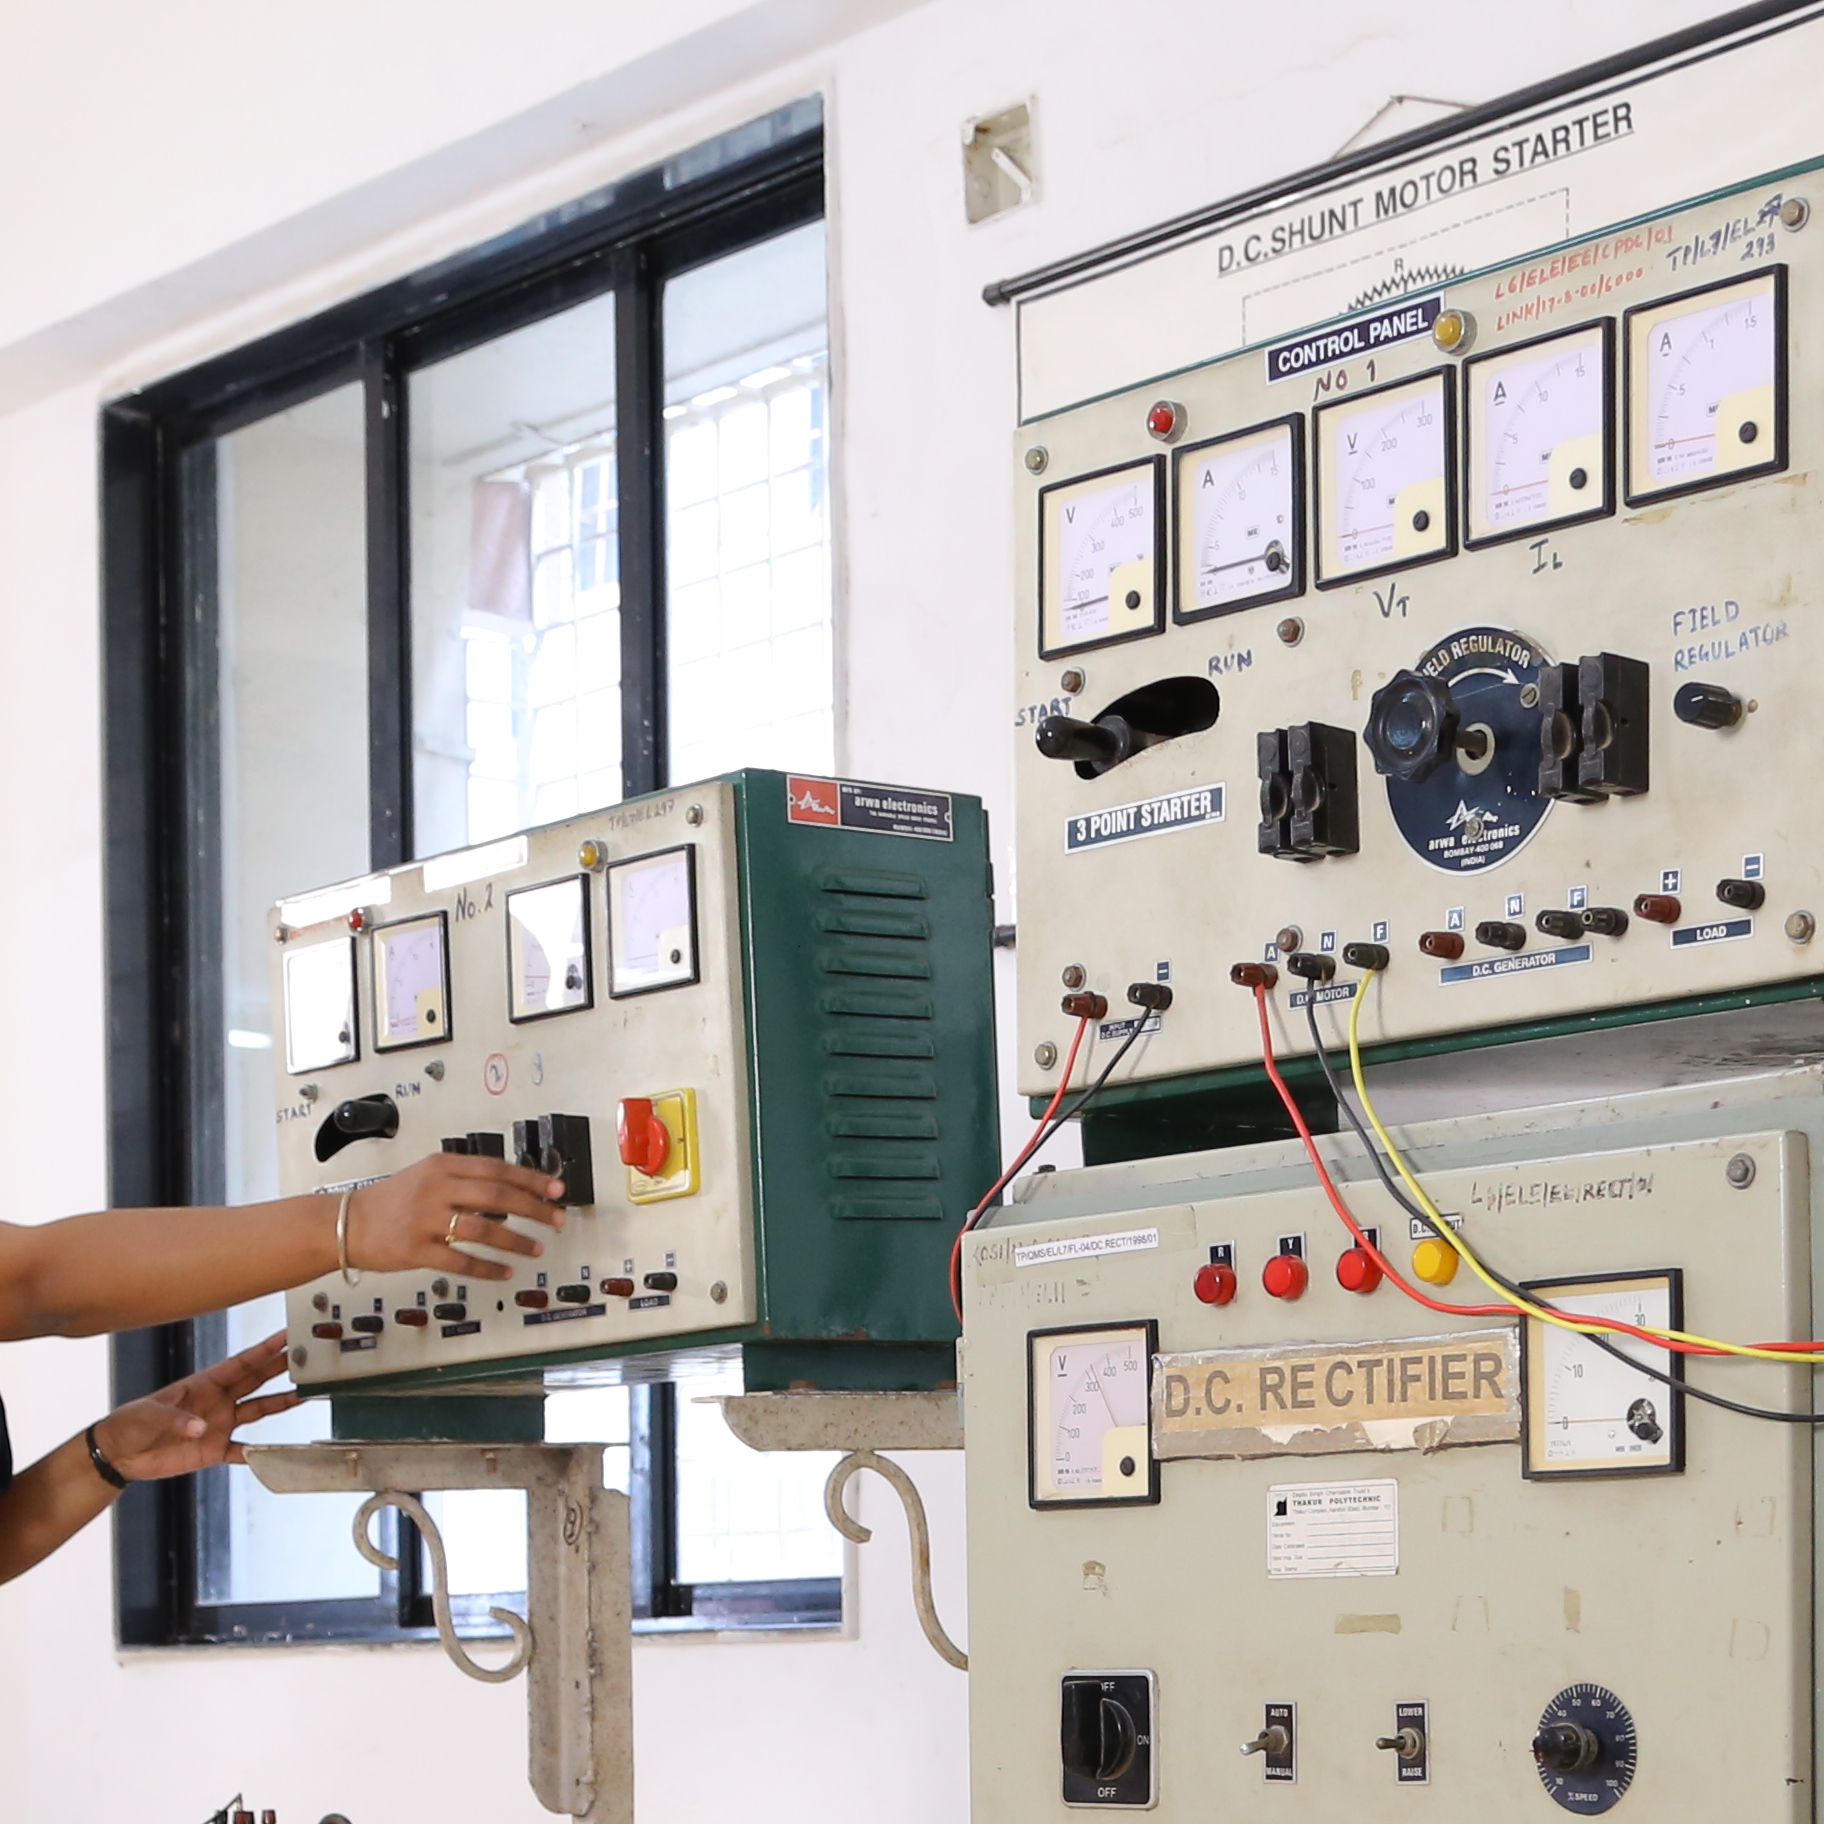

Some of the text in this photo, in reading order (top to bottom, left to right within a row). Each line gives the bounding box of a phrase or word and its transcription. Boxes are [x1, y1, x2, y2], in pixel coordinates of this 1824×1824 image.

[1376, 158, 1477, 219] MOTOR
[1493, 101, 1633, 177] STARTER
[1394, 258, 1404, 273] R
[1278, 308, 1428, 372] CONTROL PANEL
[1659, 332, 1672, 352] A
[1366, 359, 1376, 382] 1
[1493, 381, 1507, 401] A
[1415, 413, 1434, 429] 300
[1346, 432, 1358, 451] V
[1380, 436, 1398, 453] 200
[1202, 469, 1215, 489] A
[1360, 477, 1377, 491] 100
[1065, 506, 1076, 524] V
[1127, 505, 1145, 521] 500
[1109, 515, 1126, 529] 400
[1673, 600, 1739, 636] FIELD
[1450, 635, 1531, 669] REGULATOR
[1674, 620, 1789, 672] REGULATOR
[1208, 649, 1252, 676] RUN
[1014, 697, 1072, 727] START
[854, 795, 881, 809] arwa
[882, 798, 938, 816] electronics
[1077, 791, 1211, 841] 3 POINT STARTER
[1427, 835, 1456, 851] arwa
[1459, 854, 1487, 868] (INDIA)
[485, 882, 493, 911] 2
[1572, 891, 1583, 907] F
[1509, 898, 1520, 914] N
[1449, 911, 1460, 928] A
[1376, 925, 1385, 939] F
[1695, 924, 1727, 941] LOAD
[1323, 934, 1333, 949] N
[1266, 945, 1276, 960] A
[1471, 953, 1555, 977] D.C. GENERATOR
[1315, 986, 1350, 1003] MOTOR
[395, 1081, 421, 1099] RUN
[276, 1103, 312, 1123] START
[639, 1297, 659, 1308] LOAD
[1633, 1313, 1647, 1328] 30
[1057, 1354, 1068, 1372] V
[1122, 1359, 1139, 1372] 500
[1571, 1363, 1584, 1379] 10
[1102, 1365, 1118, 1378] 400
[1084, 1380, 1100, 1393] 300
[1165, 1351, 1504, 1418] D.C. RECTIFIER
[1071, 1402, 1088, 1416] 200
[1291, 1494, 1382, 1507] THAKUR POLYTECHNIC
[1590, 1698, 1602, 1708] 60
[1269, 1707, 1290, 1718] AUTO
[1398, 1706, 1424, 1718] LOWER
[1556, 1708, 1568, 1719] 40
[1604, 1710, 1616, 1720] 70
[1135, 1734, 1150, 1746] ON
[1265, 1766, 1294, 1777] MANUAL
[1401, 1766, 1424, 1778] RAISE
[1096, 1786, 1118, 1799] OFF
